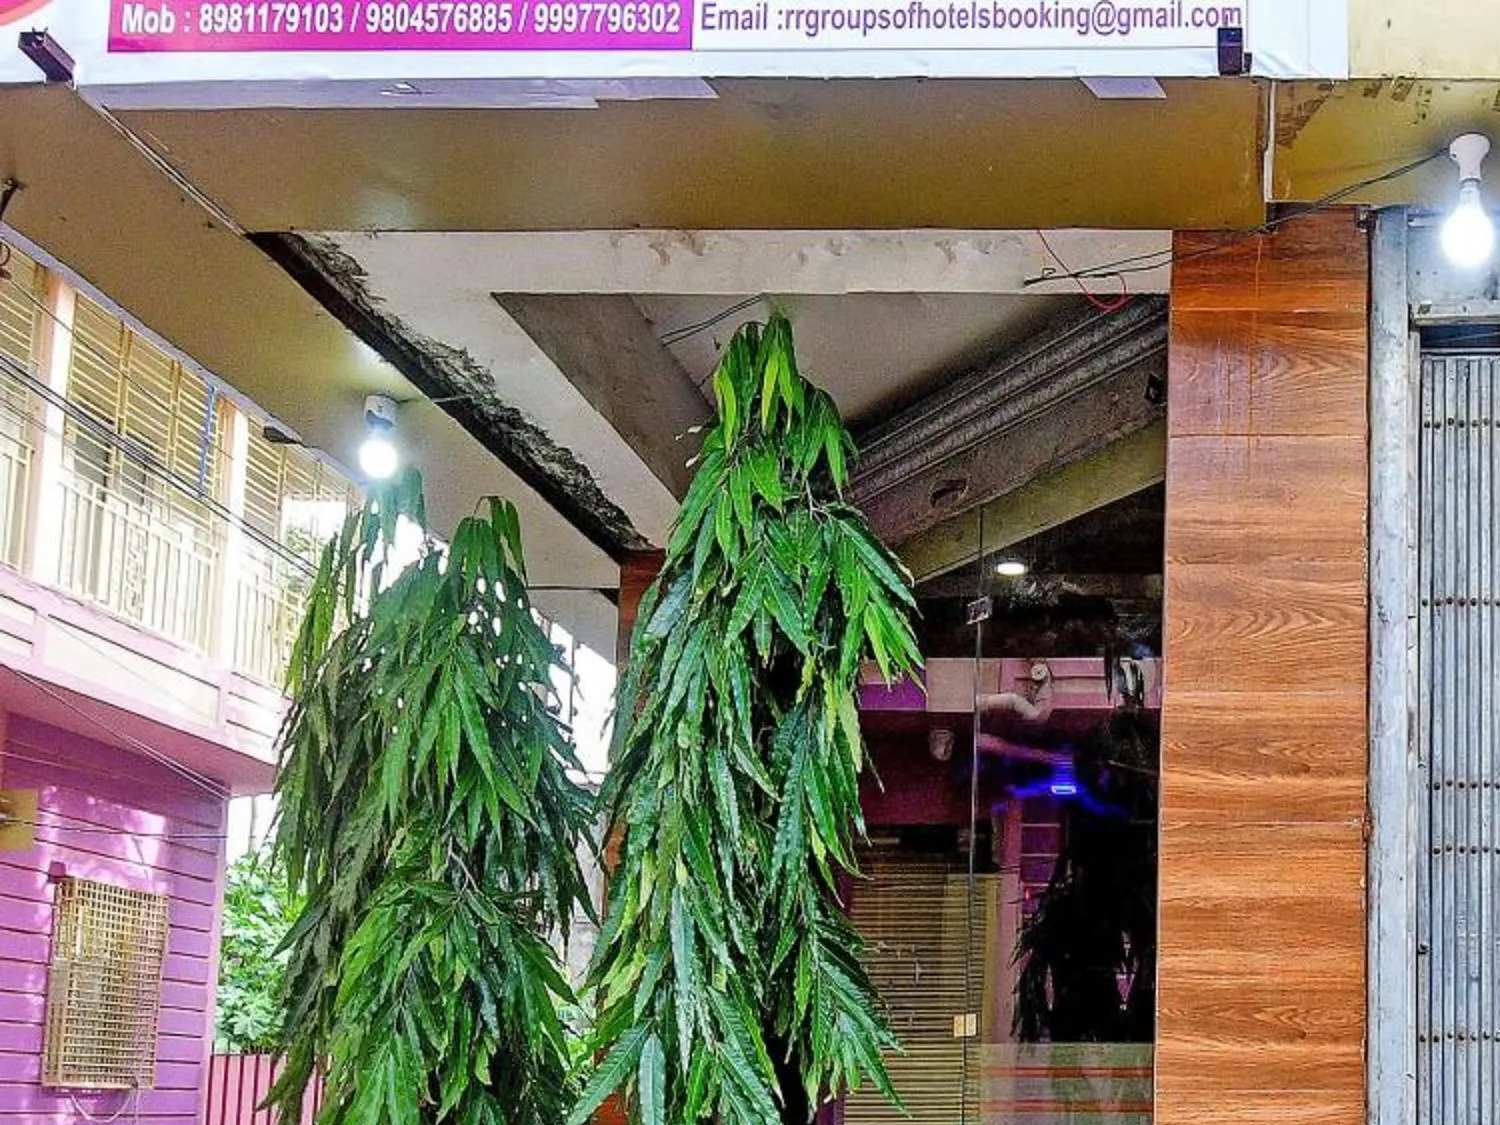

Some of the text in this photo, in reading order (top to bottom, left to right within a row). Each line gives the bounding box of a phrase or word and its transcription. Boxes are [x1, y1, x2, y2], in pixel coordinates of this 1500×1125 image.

[121, 2, 176, 34] Mob
[199, 2, 343, 34] 8981179103
[365, 2, 512, 34] 9804576885
[533, 2, 681, 33] 9997796302
[701, 1, 768, 31] Email
